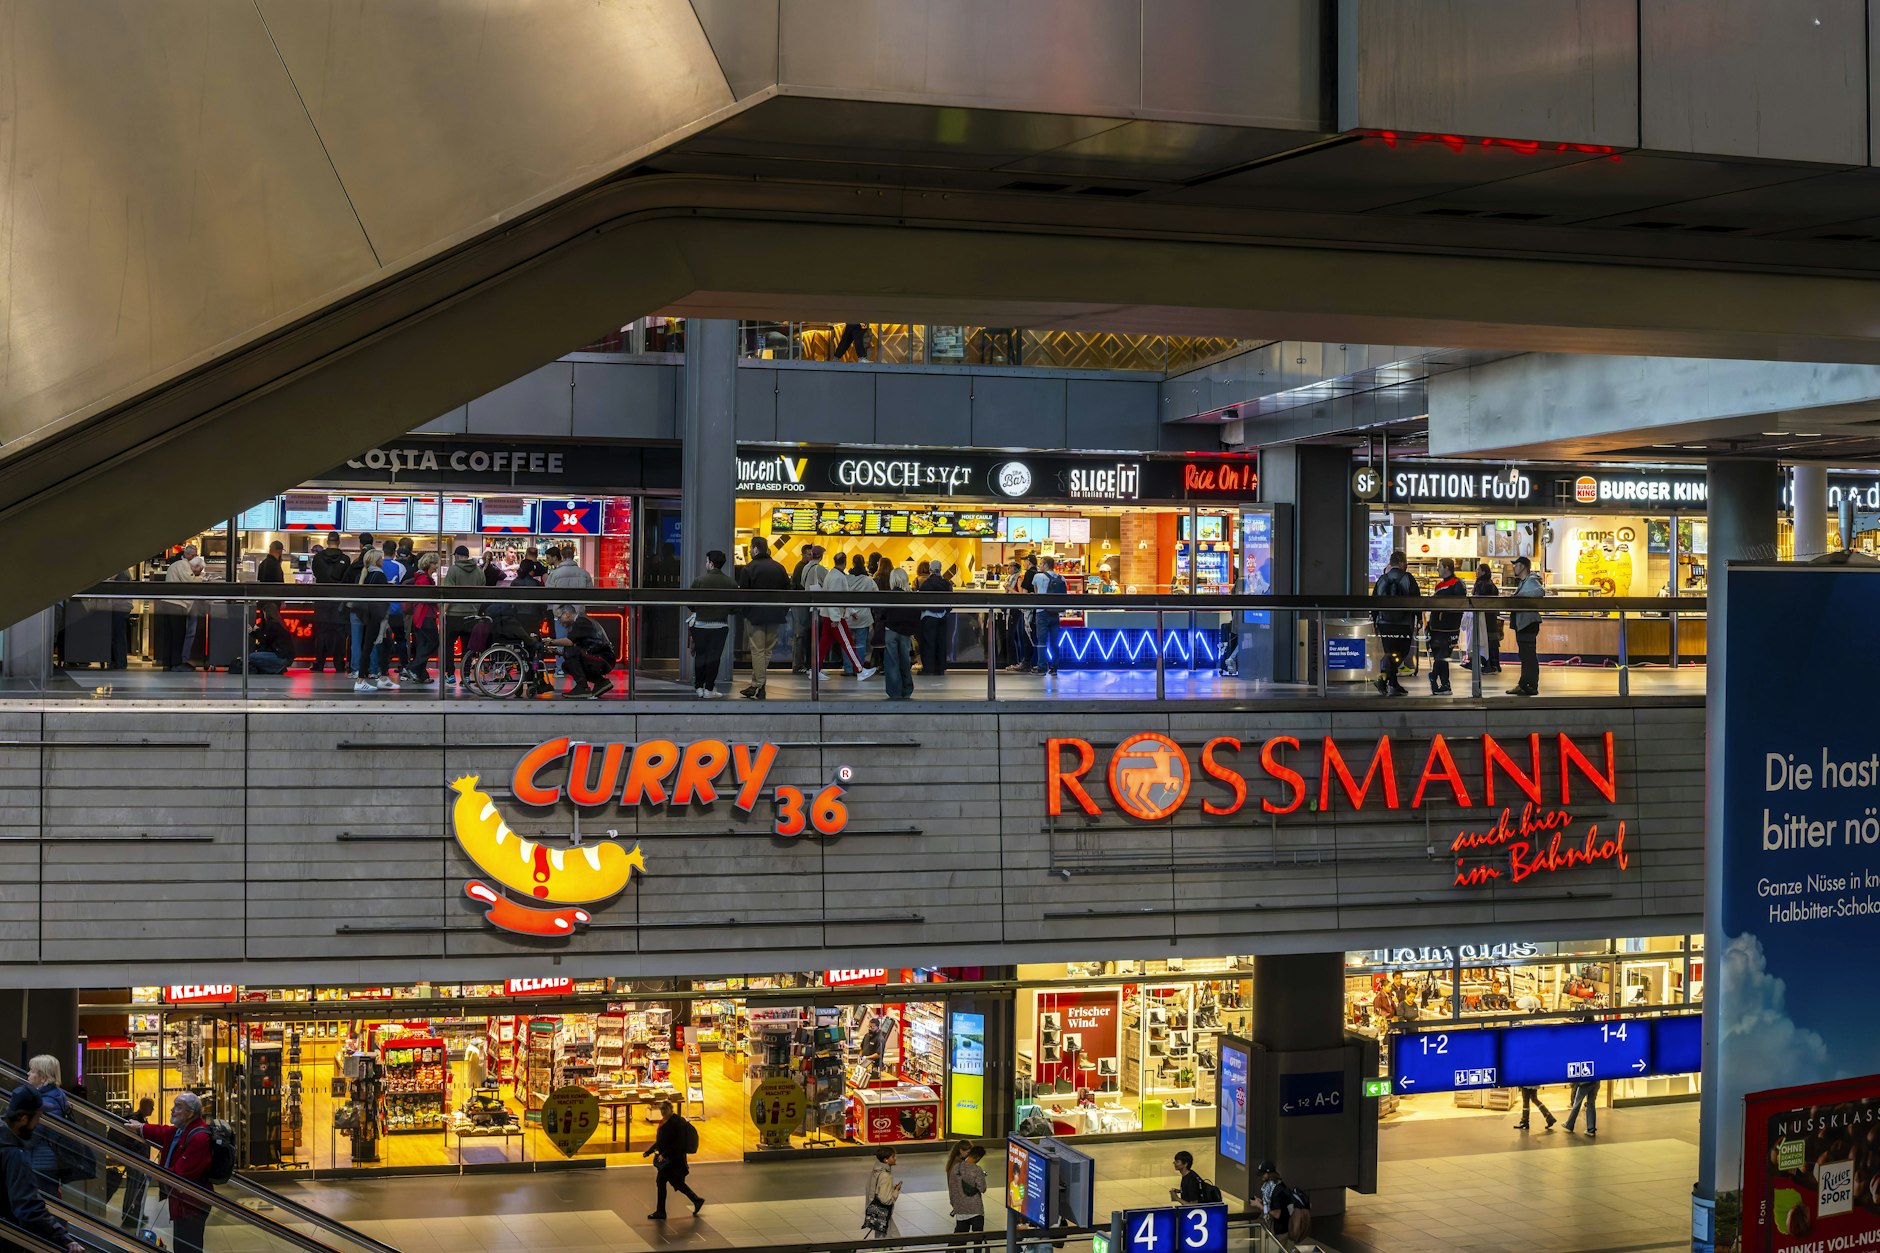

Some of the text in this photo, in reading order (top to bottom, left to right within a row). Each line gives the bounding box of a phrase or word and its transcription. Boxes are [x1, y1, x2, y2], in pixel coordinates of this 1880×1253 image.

[450, 450, 564, 473] COFFEE
[736, 457, 782, 481] incent
[839, 460, 920, 487] GOSCH
[1003, 473, 1027, 488] Bar
[1070, 469, 1116, 492] SLICE
[1185, 464, 1215, 490] Rice
[1357, 473, 1375, 492] SF
[736, 482, 805, 492] ANT BASED FOOD
[1396, 473, 1530, 499] STATION FOOD
[1599, 480, 1708, 501] BURGER KIN
[562, 513, 577, 525] 36
[1575, 530, 1614, 543] amps
[512, 737, 779, 813] CURRY
[1046, 731, 1617, 820] ROSSMANN
[1765, 746, 1880, 792] Die hast
[772, 784, 848, 836] 36
[1451, 801, 1573, 851] auch hier
[1763, 807, 1880, 850] bitter nö
[1453, 820, 1628, 887] im Bahnhof
[1757, 868, 1880, 897] Ganze Nüsse in kn
[1067, 1017, 1099, 1028] Wind.
[1068, 1007, 1110, 1017] Frischer
[1419, 1034, 1448, 1055] 1-2
[1600, 1023, 1627, 1044] 1-4
[785, 1102, 796, 1118] 5
[1298, 1091, 1340, 1107] 1-2 A-C
[578, 1111, 589, 1128] 5
[1781, 1143, 1803, 1154] OHNE
[1822, 1169, 1851, 1192] Ritter
[1821, 1189, 1851, 1205] SPORT
[1133, 1209, 1209, 1251] 4 3
